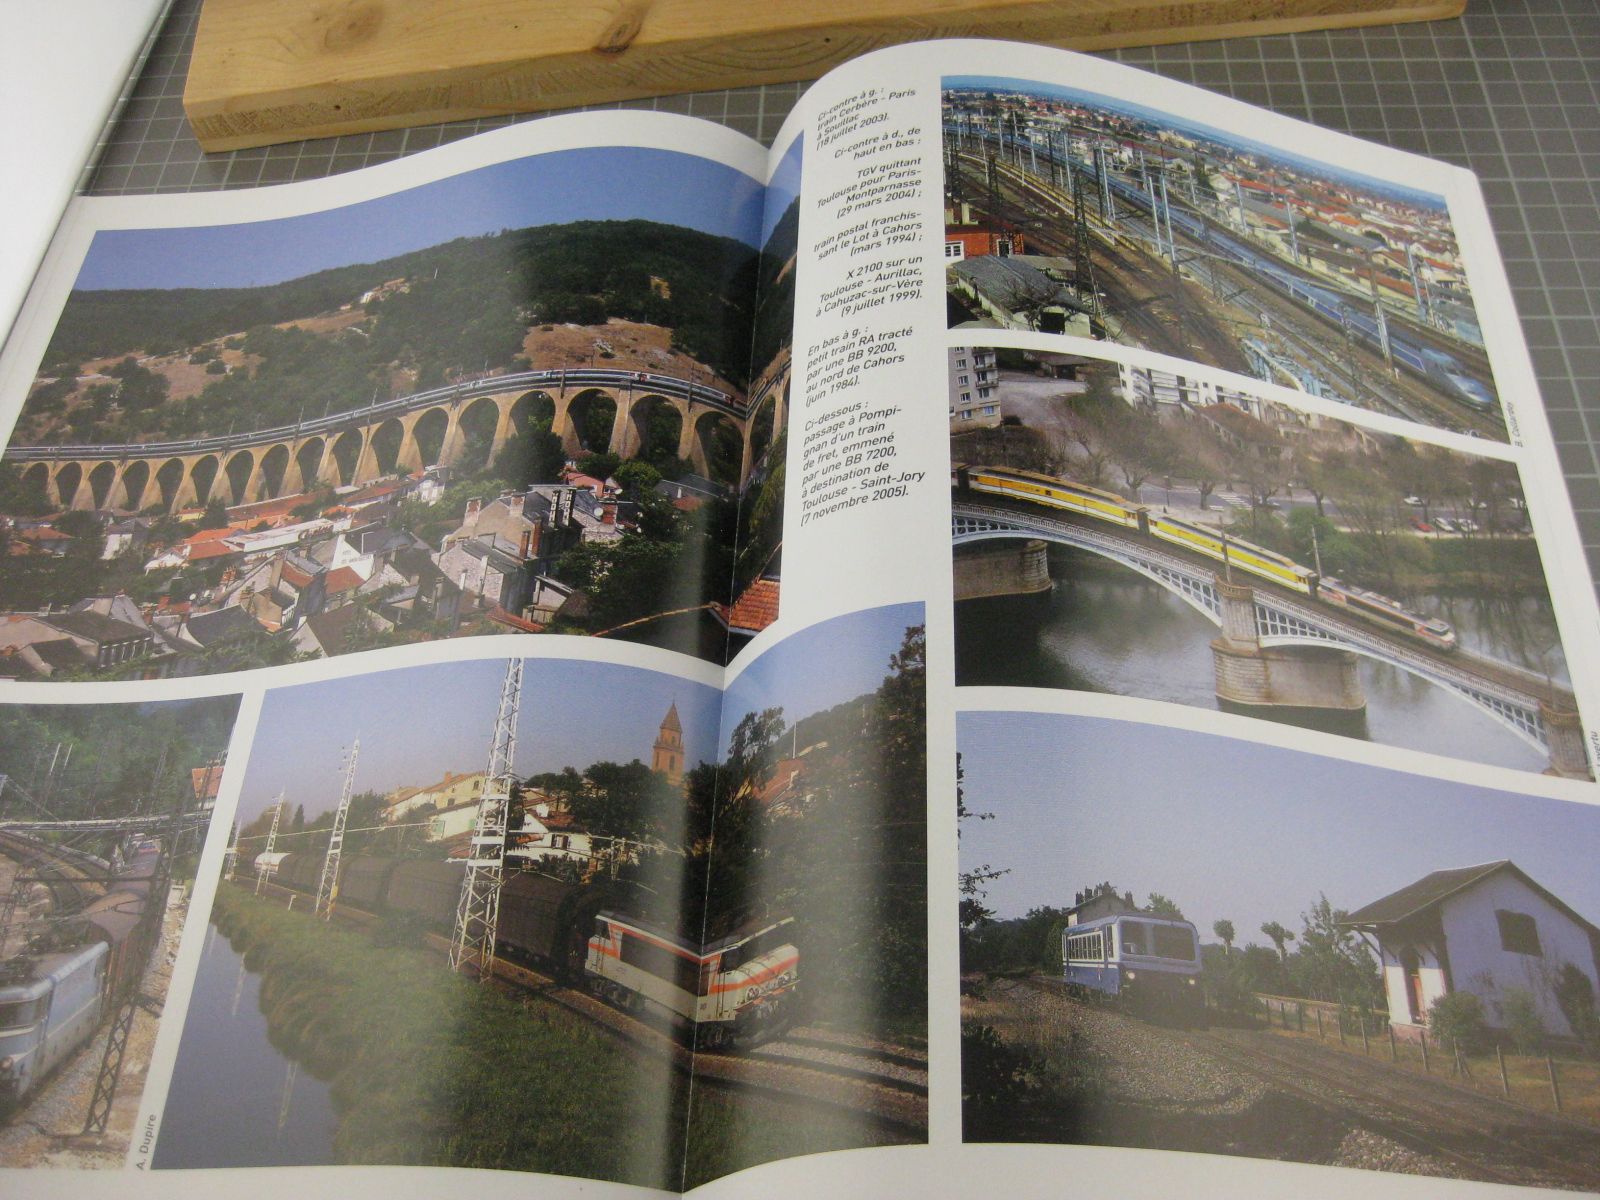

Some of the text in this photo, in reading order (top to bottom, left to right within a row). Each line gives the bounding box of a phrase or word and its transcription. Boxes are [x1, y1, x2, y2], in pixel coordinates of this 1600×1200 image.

[817, 115, 837, 131] train
[839, 98, 878, 117] Cerbère
[889, 89, 916, 100] Paris
[818, 95, 857, 121] Ci-contre
[860, 91, 866, 100] à
[868, 89, 877, 98] g.
[817, 113, 860, 141] à Souillac
[831, 125, 857, 146] juillet
[834, 135, 879, 159] Ci-contre
[882, 133, 889, 141] à
[907, 126, 921, 135] de
[854, 146, 877, 160] haut
[879, 142, 892, 152] en
[895, 137, 914, 148] bas
[857, 158, 921, 179] TGV quittant
[817, 169, 921, 208] Toulouse pour Paris-
[845, 179, 922, 204] Montparnasse
[854, 197, 882, 212] mars
[814, 210, 921, 253] train postal franchis-
[818, 222, 922, 260] sant le Lot à Cahors
[820, 280, 864, 303] Toulouse
[874, 267, 922, 283] Aurillac,
[846, 256, 923, 280] X 2100 sur un
[816, 279, 923, 318] à Cahuzac-sur-Vère
[852, 297, 885, 316] juillet
[807, 326, 913, 371] petit train RA tracté
[808, 345, 820, 357] En
[822, 335, 840, 349] bas
[842, 330, 849, 340] à
[852, 328, 861, 339] g.
[806, 342, 897, 384] par une BB 9200,
[806, 354, 905, 394] au nord de Cahors
[803, 405, 902, 447] passage à Pompi-
[804, 402, 862, 432] Ci-dessous
[803, 440, 828, 461] gnan
[858, 421, 886, 437] train
[803, 432, 895, 472] de fret, emmené
[801, 461, 889, 499] à destination de
[802, 446, 897, 488] par une BB 7200,
[802, 486, 848, 512] Toulouse
[860, 471, 926, 490] Saint-Jory
[812, 493, 868, 521] novembre
[136, 1114, 156, 1171] A. Dupire
